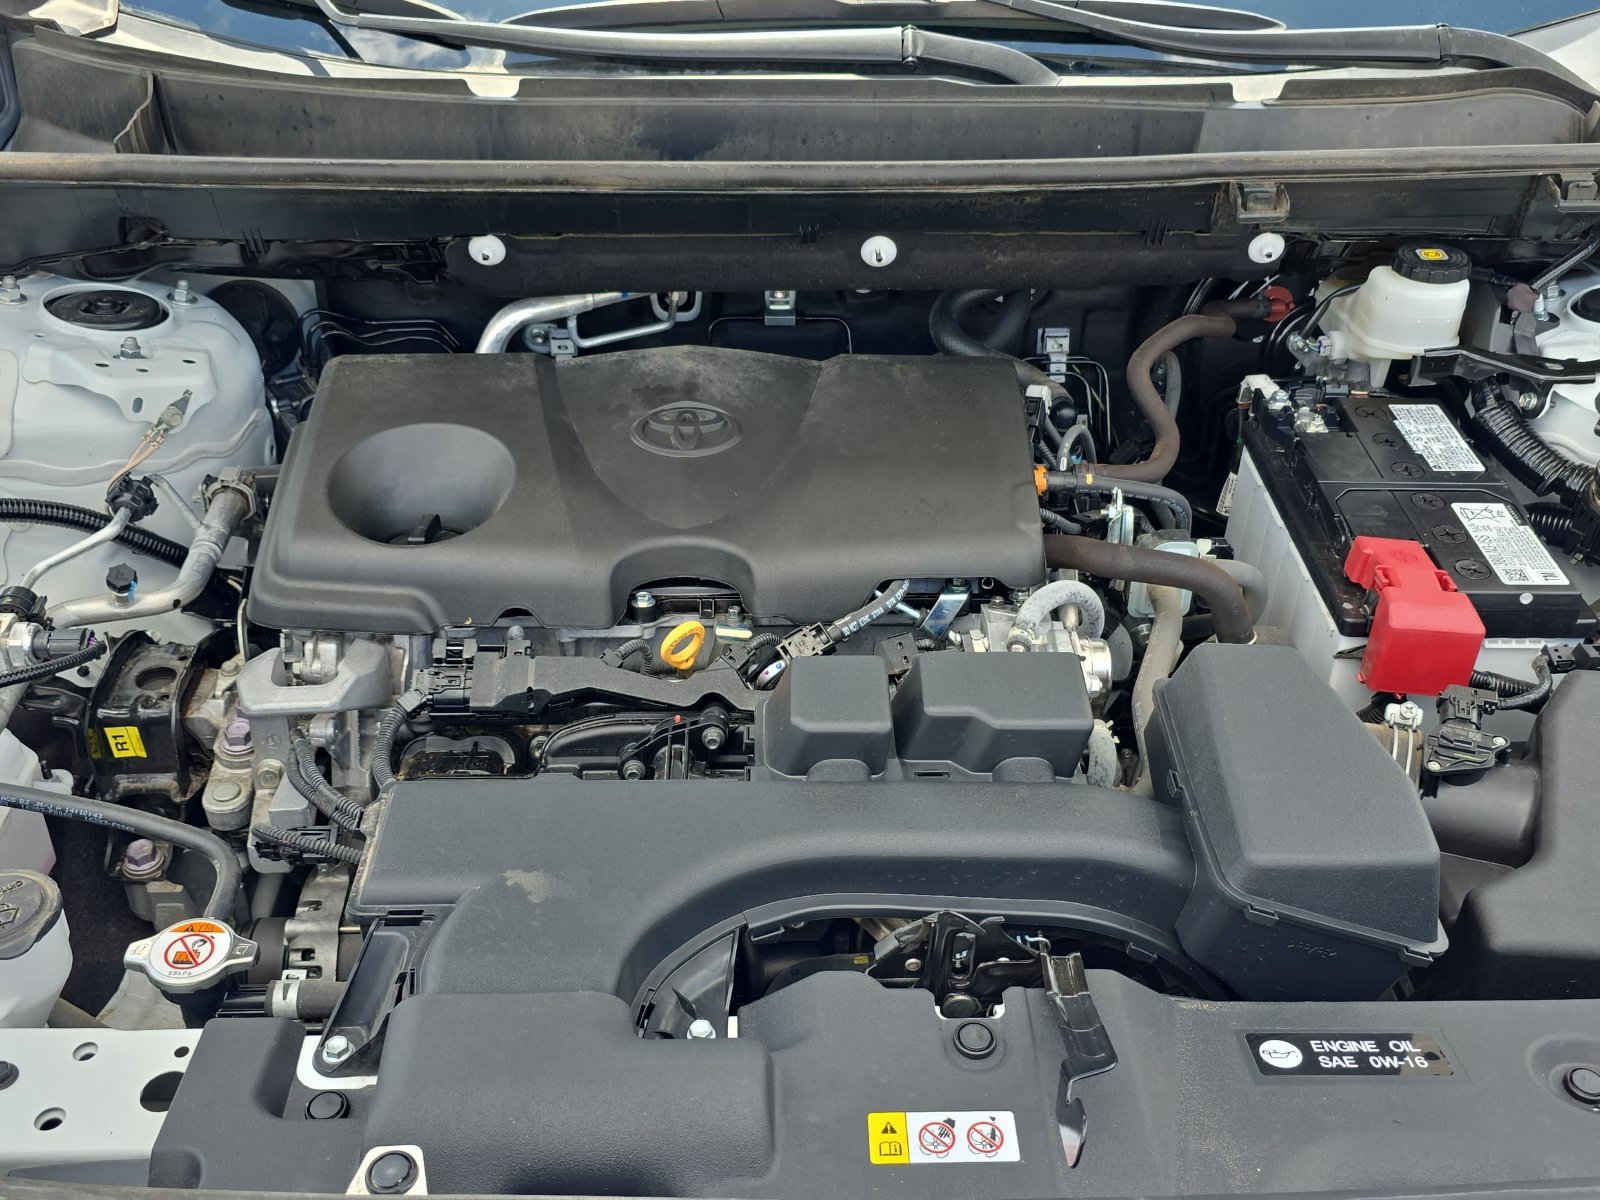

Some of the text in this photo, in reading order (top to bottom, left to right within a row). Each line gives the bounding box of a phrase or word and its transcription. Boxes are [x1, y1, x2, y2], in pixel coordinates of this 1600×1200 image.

[112, 735, 129, 752] R1
[0, 880, 24, 893] LUID
[1309, 1039, 1421, 1053] ENGINE OIL
[1319, 1056, 1429, 1069] SAE 0W-16
